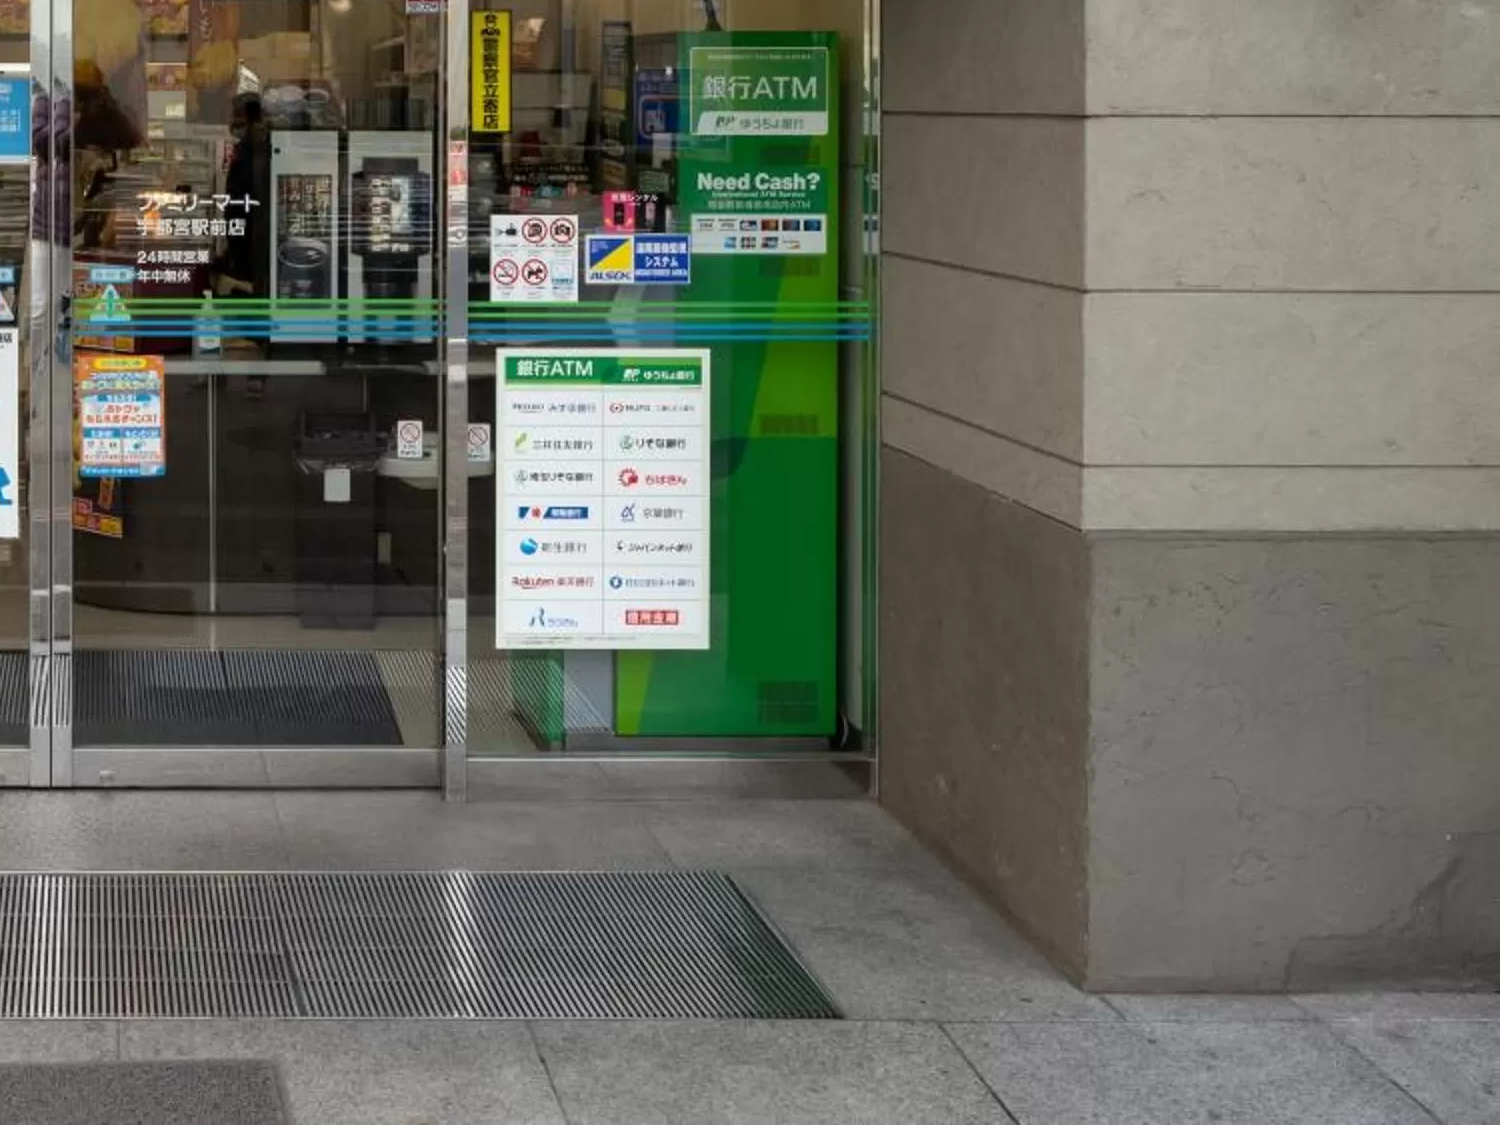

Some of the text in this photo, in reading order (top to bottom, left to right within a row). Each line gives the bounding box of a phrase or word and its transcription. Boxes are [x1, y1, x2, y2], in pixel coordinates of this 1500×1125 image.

[702, 75, 817, 100] 銀行ATM
[697, 172, 820, 190] Need Cash?
[136, 216, 246, 236] 宇都宮駅前店
[137, 250, 209, 264] 24時間営業
[517, 360, 593, 377] 銀行ATM
[644, 370, 695, 381] ゆうちょ銀行
[635, 437, 687, 450] りそな銀行
